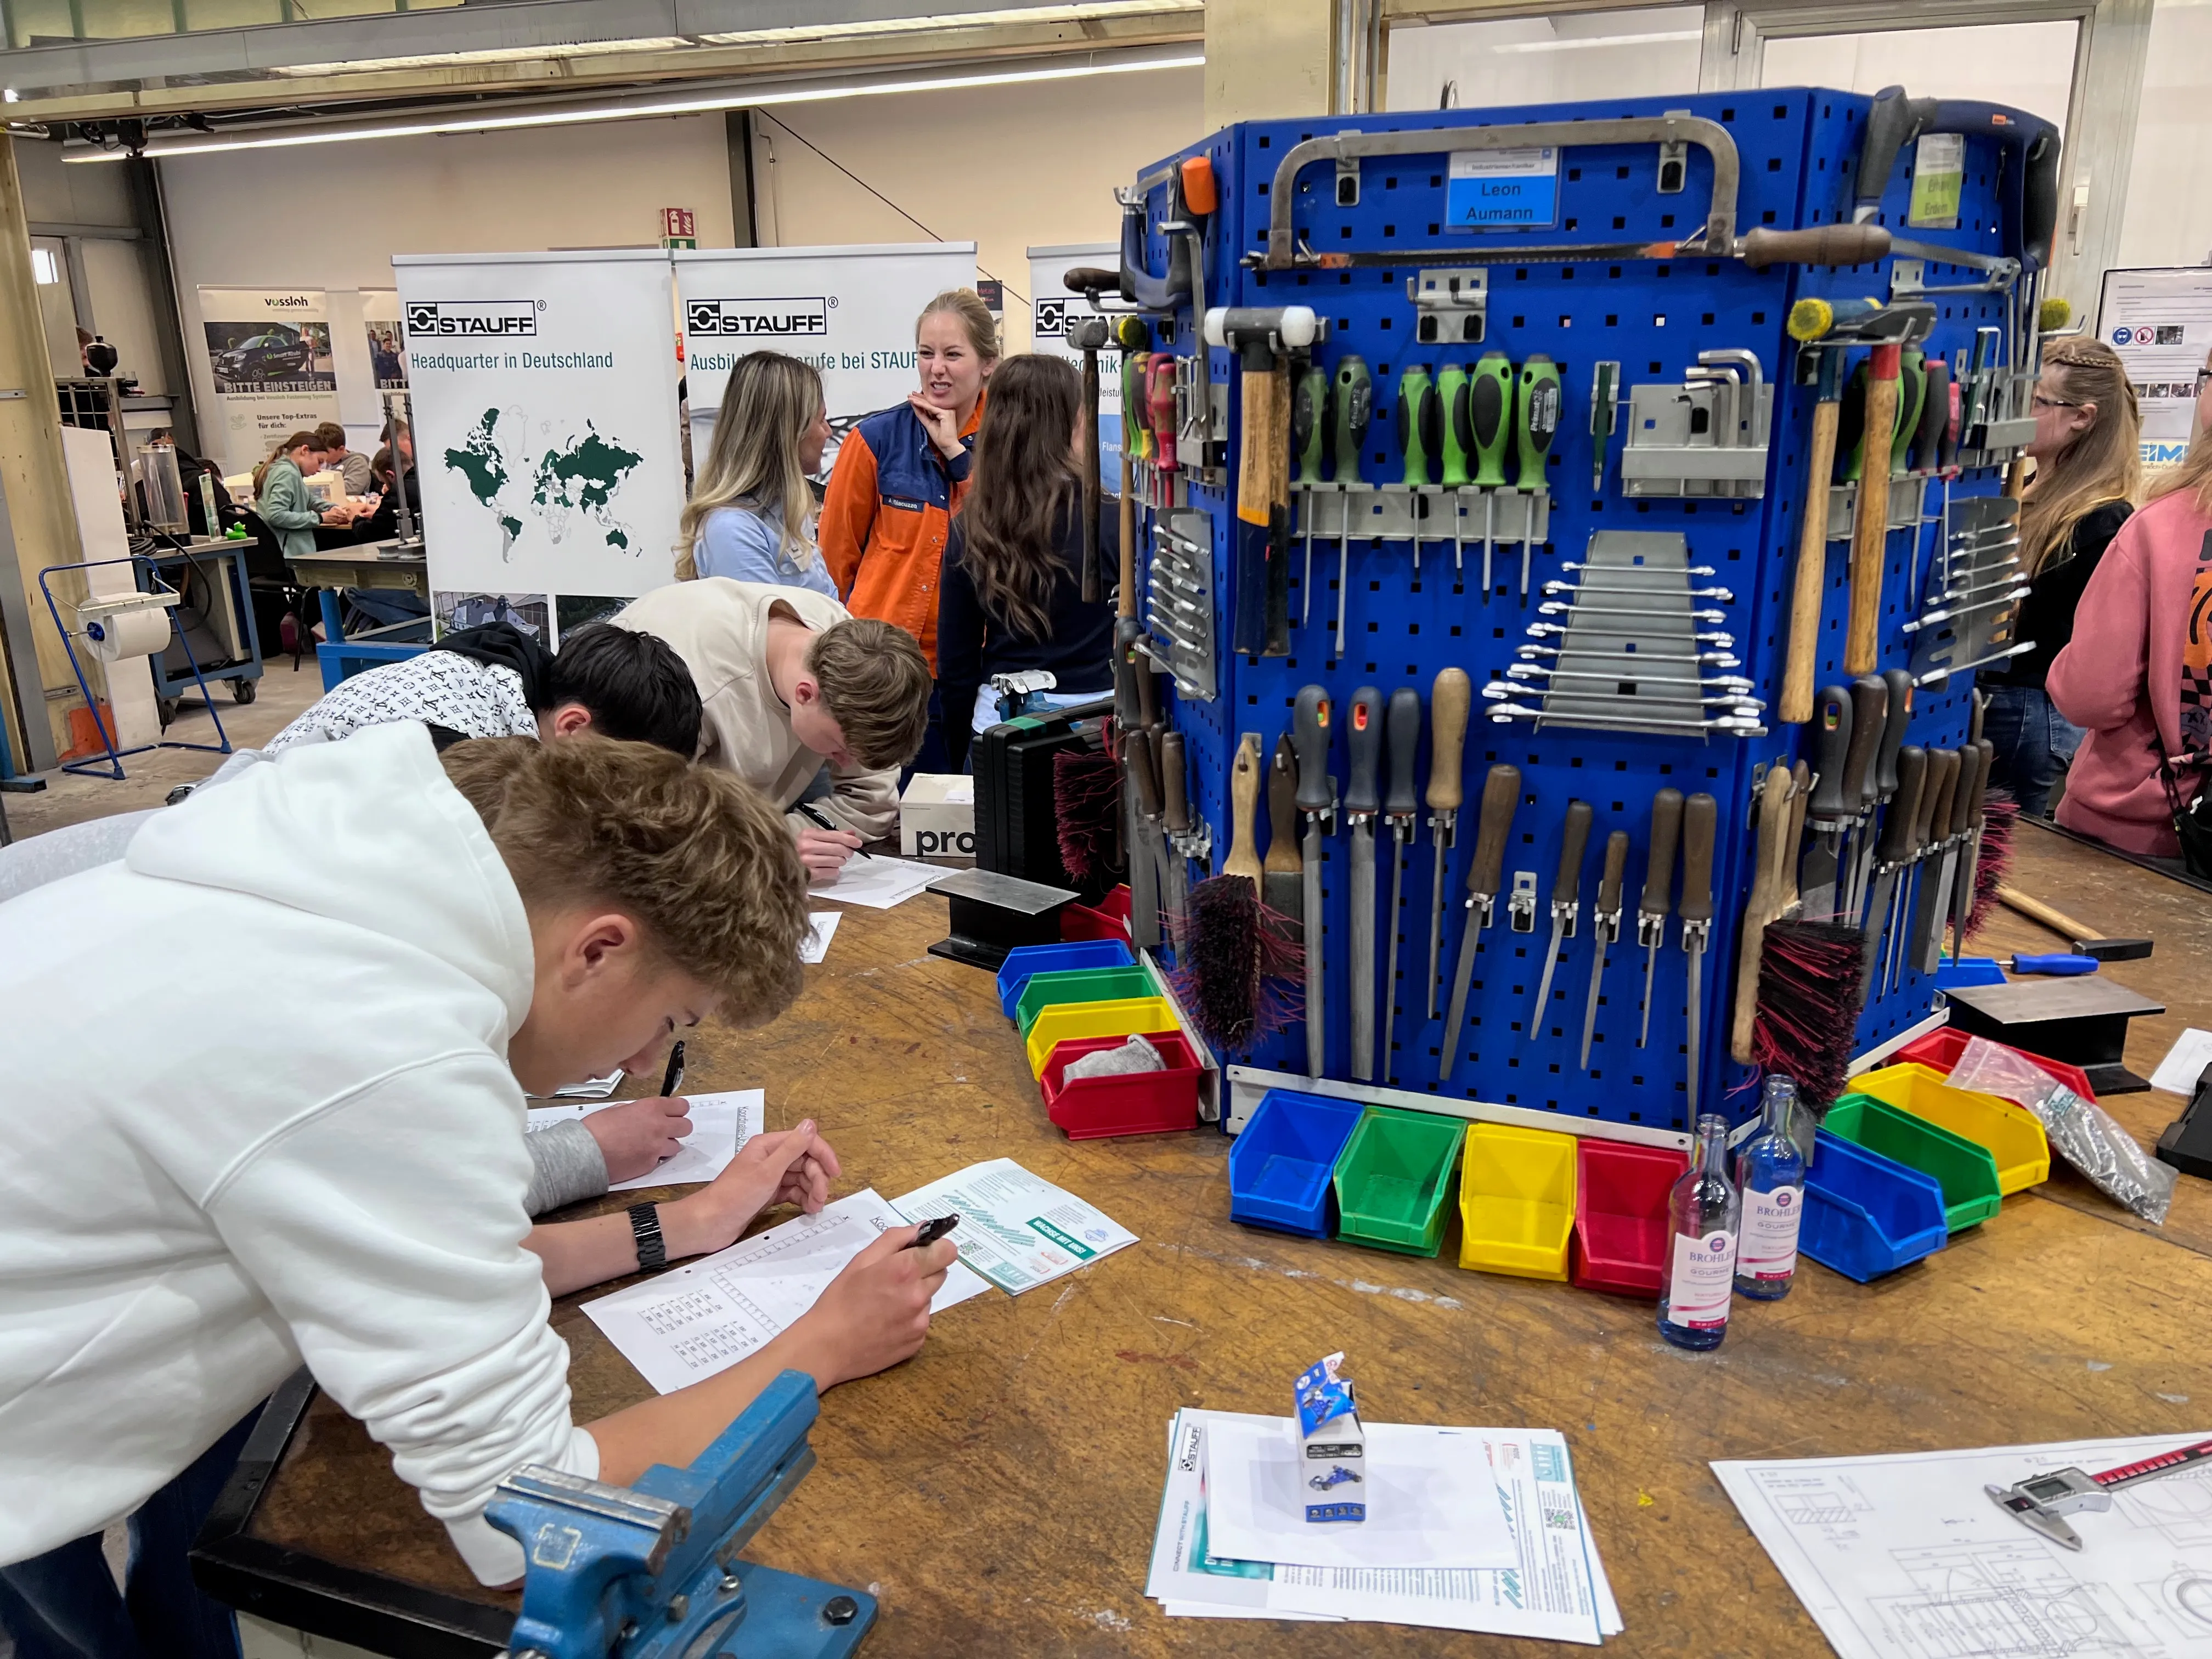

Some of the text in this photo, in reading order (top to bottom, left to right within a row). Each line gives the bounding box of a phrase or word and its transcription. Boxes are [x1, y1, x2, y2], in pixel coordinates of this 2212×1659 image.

[1481, 182, 1521, 196] Leon
[1466, 207, 1533, 221] Aumann
[264, 296, 308, 307] vossloh
[440, 317, 533, 333] STAUFF
[722, 315, 824, 332] STAUFF
[411, 352, 613, 372] Headquarter in Deutschland
[842, 352, 865, 369] bei
[224, 380, 332, 393] BITTE EINSTEIGEN
[380, 379, 408, 389] BITT
[1033, 1219, 1087, 1254] WACHSE MIT UNS!
[1187, 1427, 1200, 1460] STAUFF
